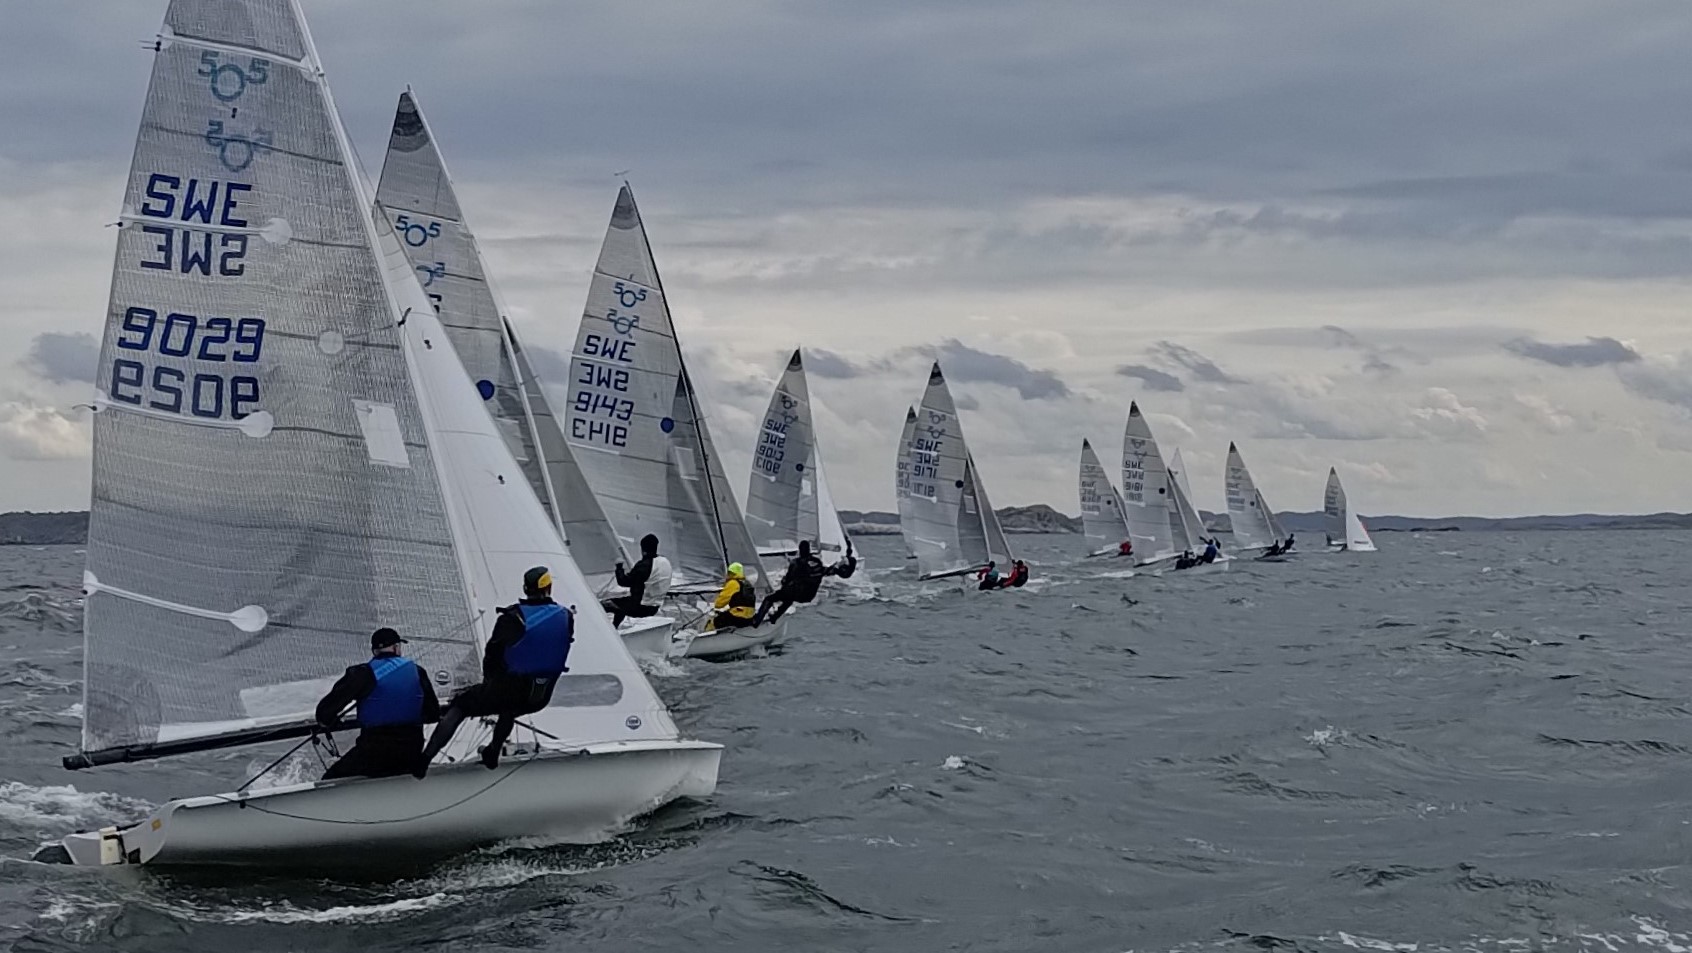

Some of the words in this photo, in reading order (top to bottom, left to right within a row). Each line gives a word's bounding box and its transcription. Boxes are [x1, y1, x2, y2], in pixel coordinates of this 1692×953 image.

[198, 51, 270, 100] 505
[141, 173, 252, 227] SWE
[395, 215, 441, 247] 505
[613, 282, 648, 308] 505
[117, 306, 266, 363] 9029
[583, 334, 636, 362] SWE
[574, 391, 635, 422] 9143
[765, 419, 791, 434] SWE
[915, 438, 943, 453] SWE
[913, 465, 938, 479] 9171
